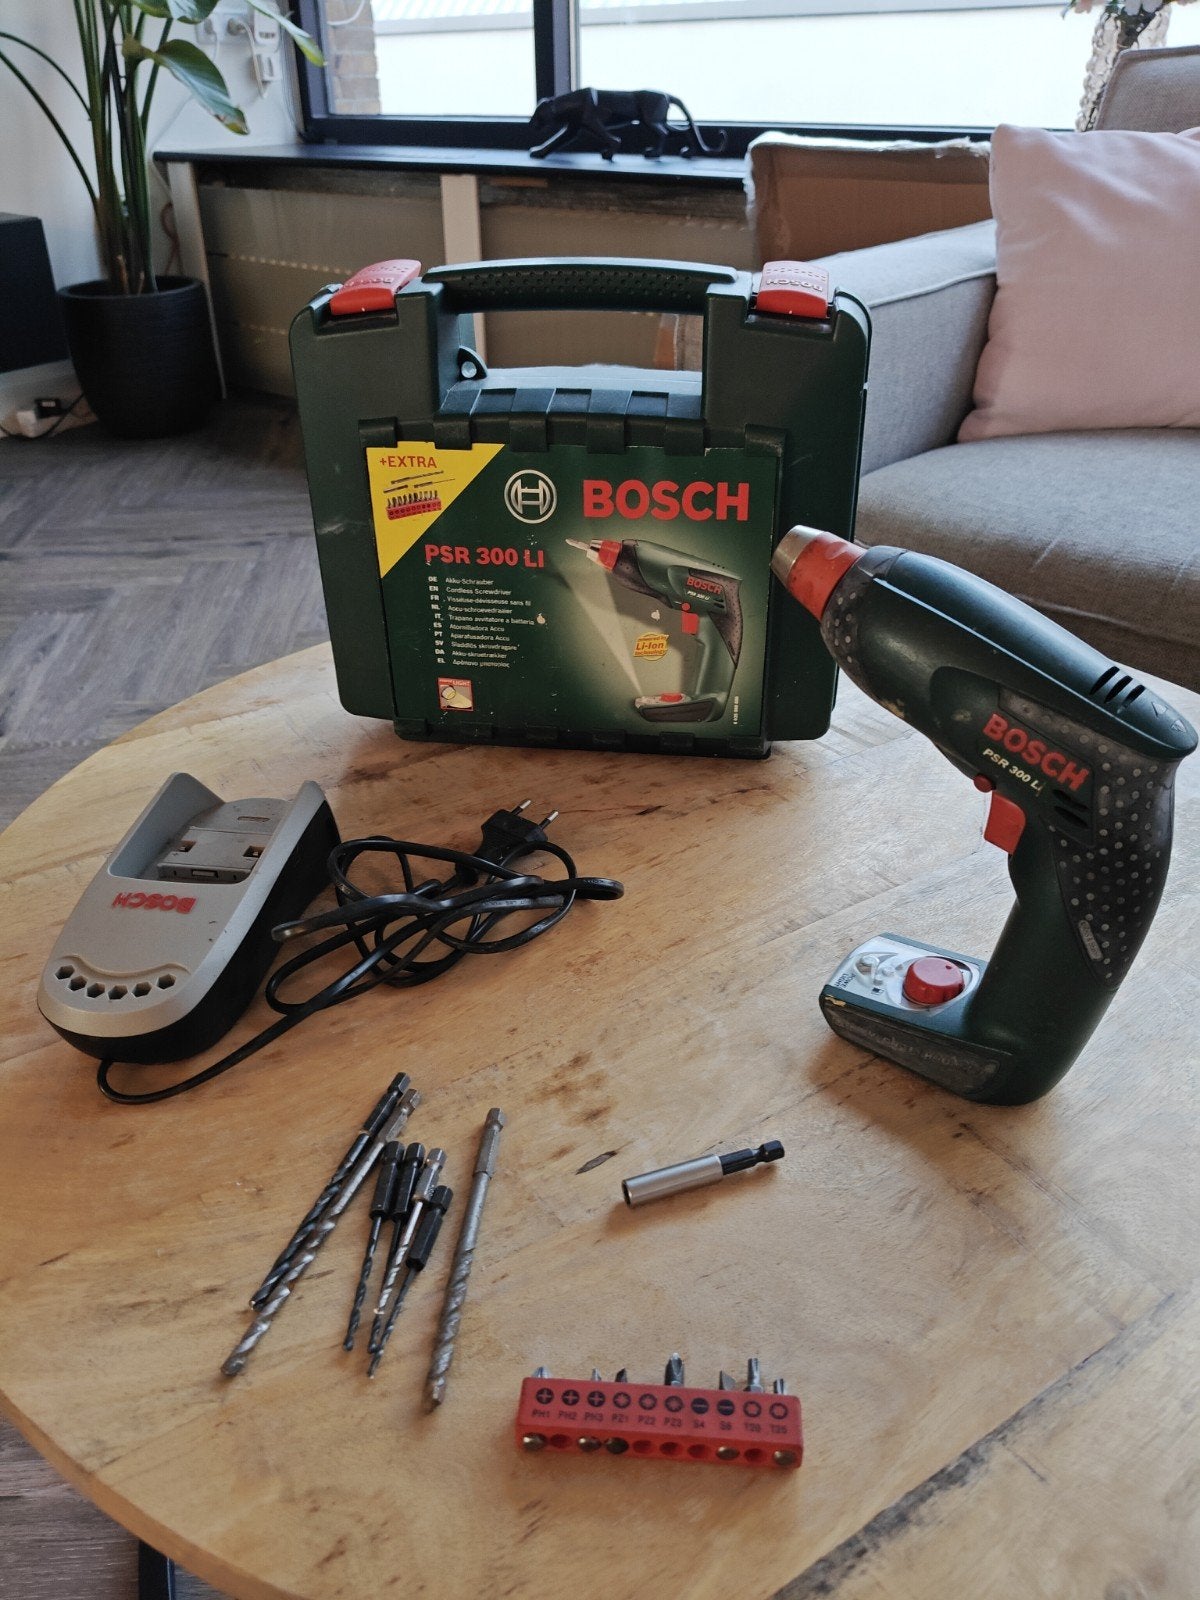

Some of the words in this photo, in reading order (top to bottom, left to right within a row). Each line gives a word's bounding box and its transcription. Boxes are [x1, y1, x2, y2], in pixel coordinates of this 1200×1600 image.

[380, 455, 437, 468] +EXTRA
[583, 479, 749, 521] BOSCH
[425, 545, 470, 565] PSR
[476, 547, 518, 566] 300
[524, 550, 544, 567] LI
[446, 577, 494, 585] Akku-Schrauber
[686, 576, 722, 595] BOSCH
[446, 586, 473, 594] Cordless
[475, 588, 512, 596] Screwdriver
[449, 614, 473, 622] Trapano
[636, 642, 664, 651] Li-Ion
[982, 712, 1090, 792] BOSCH
[982, 748, 1010, 769] PSR
[1008, 765, 1031, 783] 300
[112, 892, 197, 914] BOSCH
[532, 1409, 550, 1418] PH1
[558, 1410, 577, 1420] PH2
[584, 1411, 604, 1421] PH3
[638, 1415, 656, 1425] PZ2
[664, 1416, 682, 1427] PZ3
